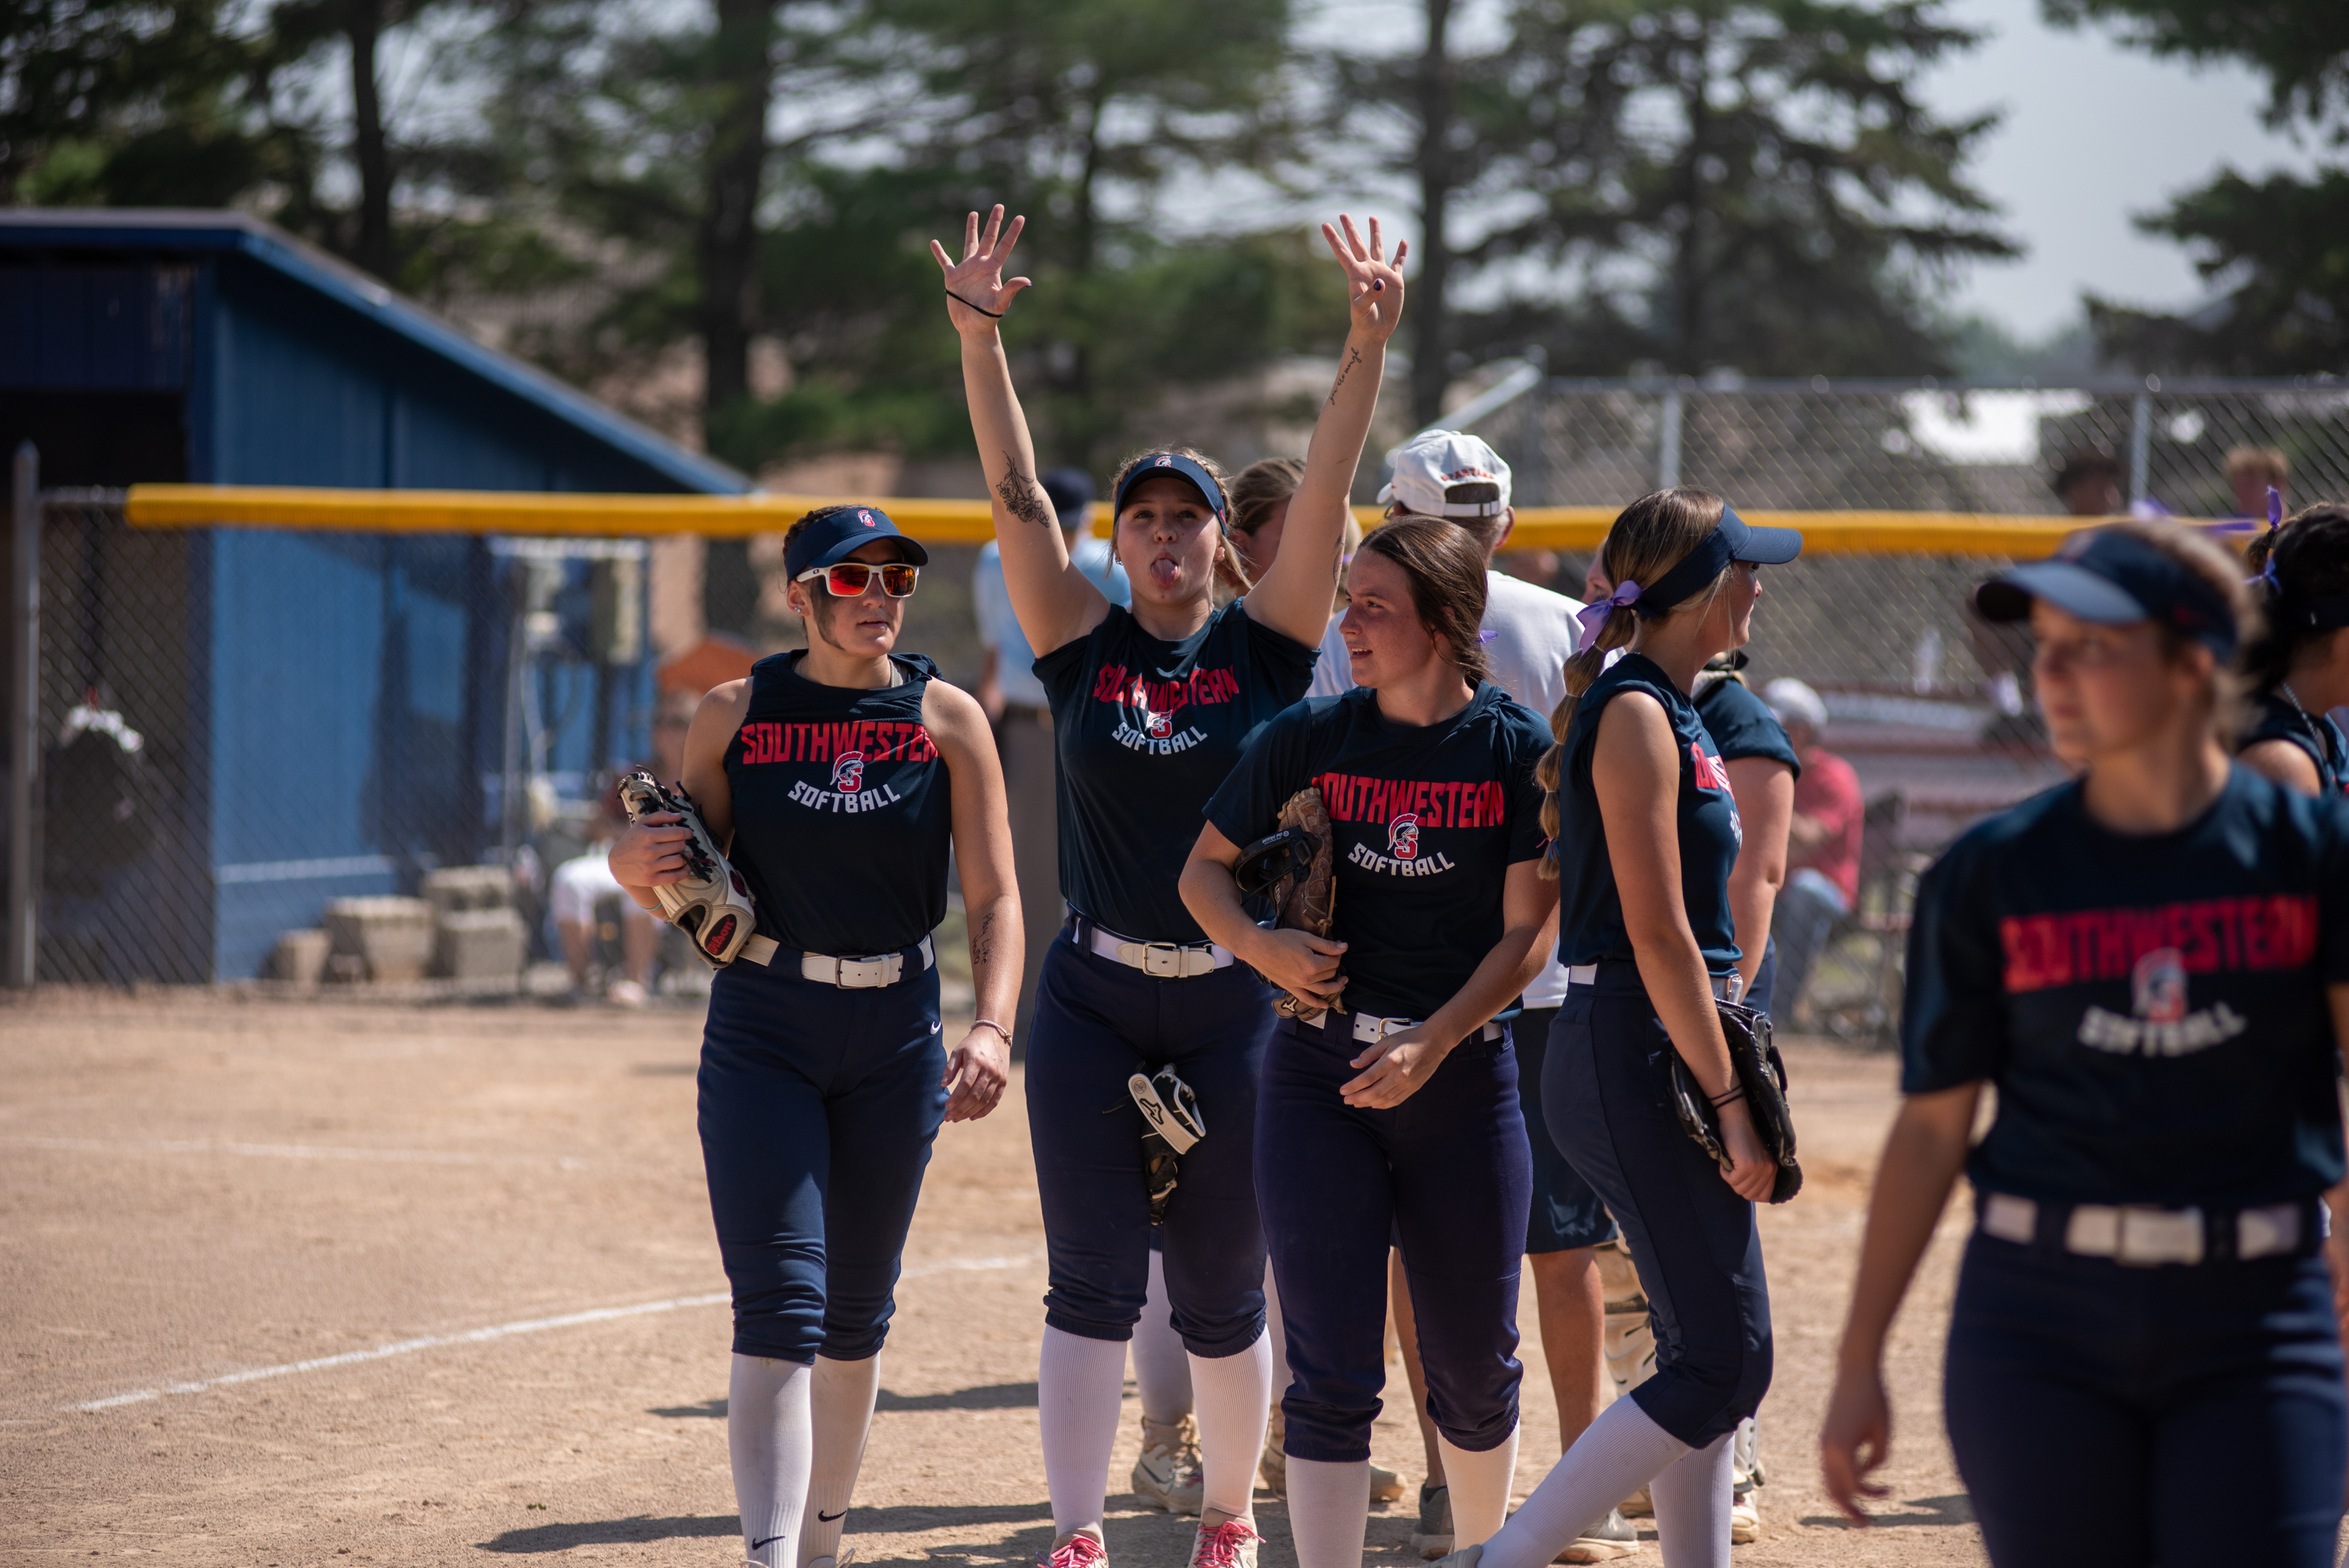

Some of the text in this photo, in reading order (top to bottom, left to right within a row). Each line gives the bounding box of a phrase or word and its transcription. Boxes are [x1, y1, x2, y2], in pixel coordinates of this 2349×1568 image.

[740, 720, 940, 765] SOUTHWESTER
[1111, 721, 1208, 756] SOFTBALL
[787, 780, 901, 814] SOFTBALL
[1347, 842, 1456, 877] SOFTBALL
